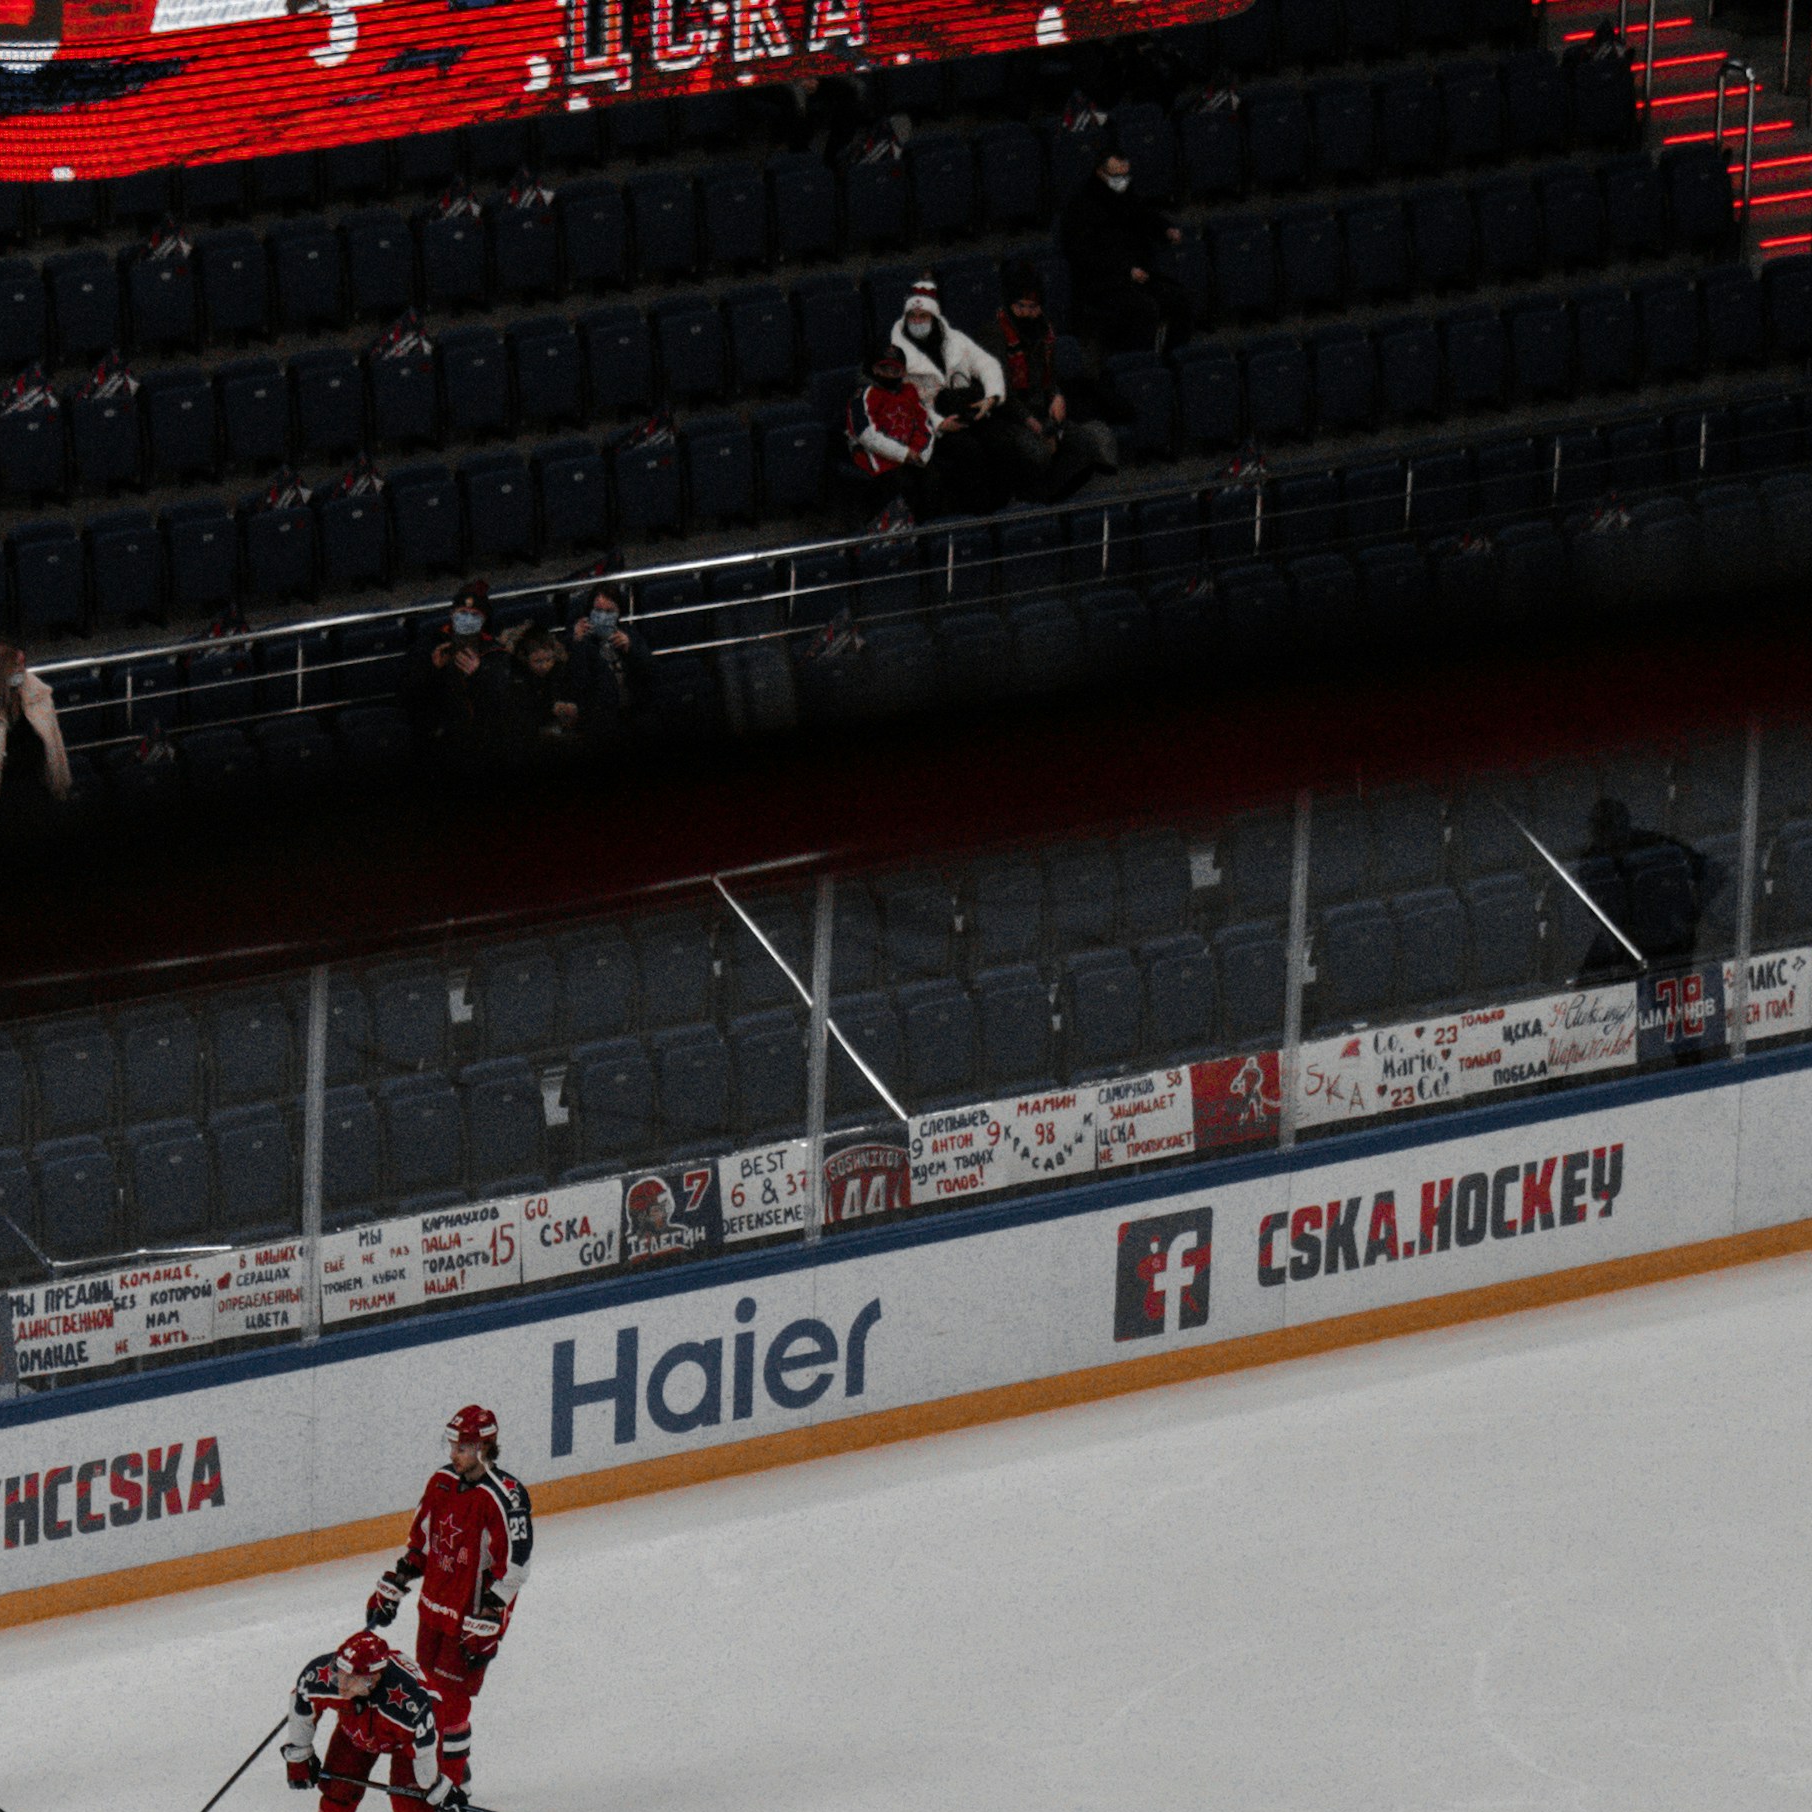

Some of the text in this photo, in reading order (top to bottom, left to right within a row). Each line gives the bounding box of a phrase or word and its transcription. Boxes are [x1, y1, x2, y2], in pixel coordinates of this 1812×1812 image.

[1433, 1024, 1459, 1046] 23
[1016, 1095, 1077, 1118] МАМИН
[1390, 1085, 1416, 1108] 23
[931, 1134, 973, 1155] АНТОН
[1034, 1121, 1056, 1147] 98
[1098, 1121, 1136, 1147] ЦСКА
[740, 1149, 788, 1179] BEST
[683, 1168, 713, 1212] 7
[731, 1183, 746, 1208] 6
[421, 1205, 500, 1234] КАРНАУХОВ
[722, 1204, 804, 1236] DEFENSEME
[1257, 1143, 1625, 1288] CSKA.HOCKEY
[358, 1228, 383, 1248] МЫ
[488, 1221, 516, 1268] 15
[149, 1279, 213, 1306] КОТОРОЙ
[348, 1291, 397, 1313] РУКАМИ
[145, 1310, 181, 1329] НАМ
[245, 1310, 290, 1331] ЦВЕТА
[18, 1340, 89, 1374] ОМАНДЕ
[550, 1296, 883, 1459] Haier
[508, 1515, 529, 1541] 23
